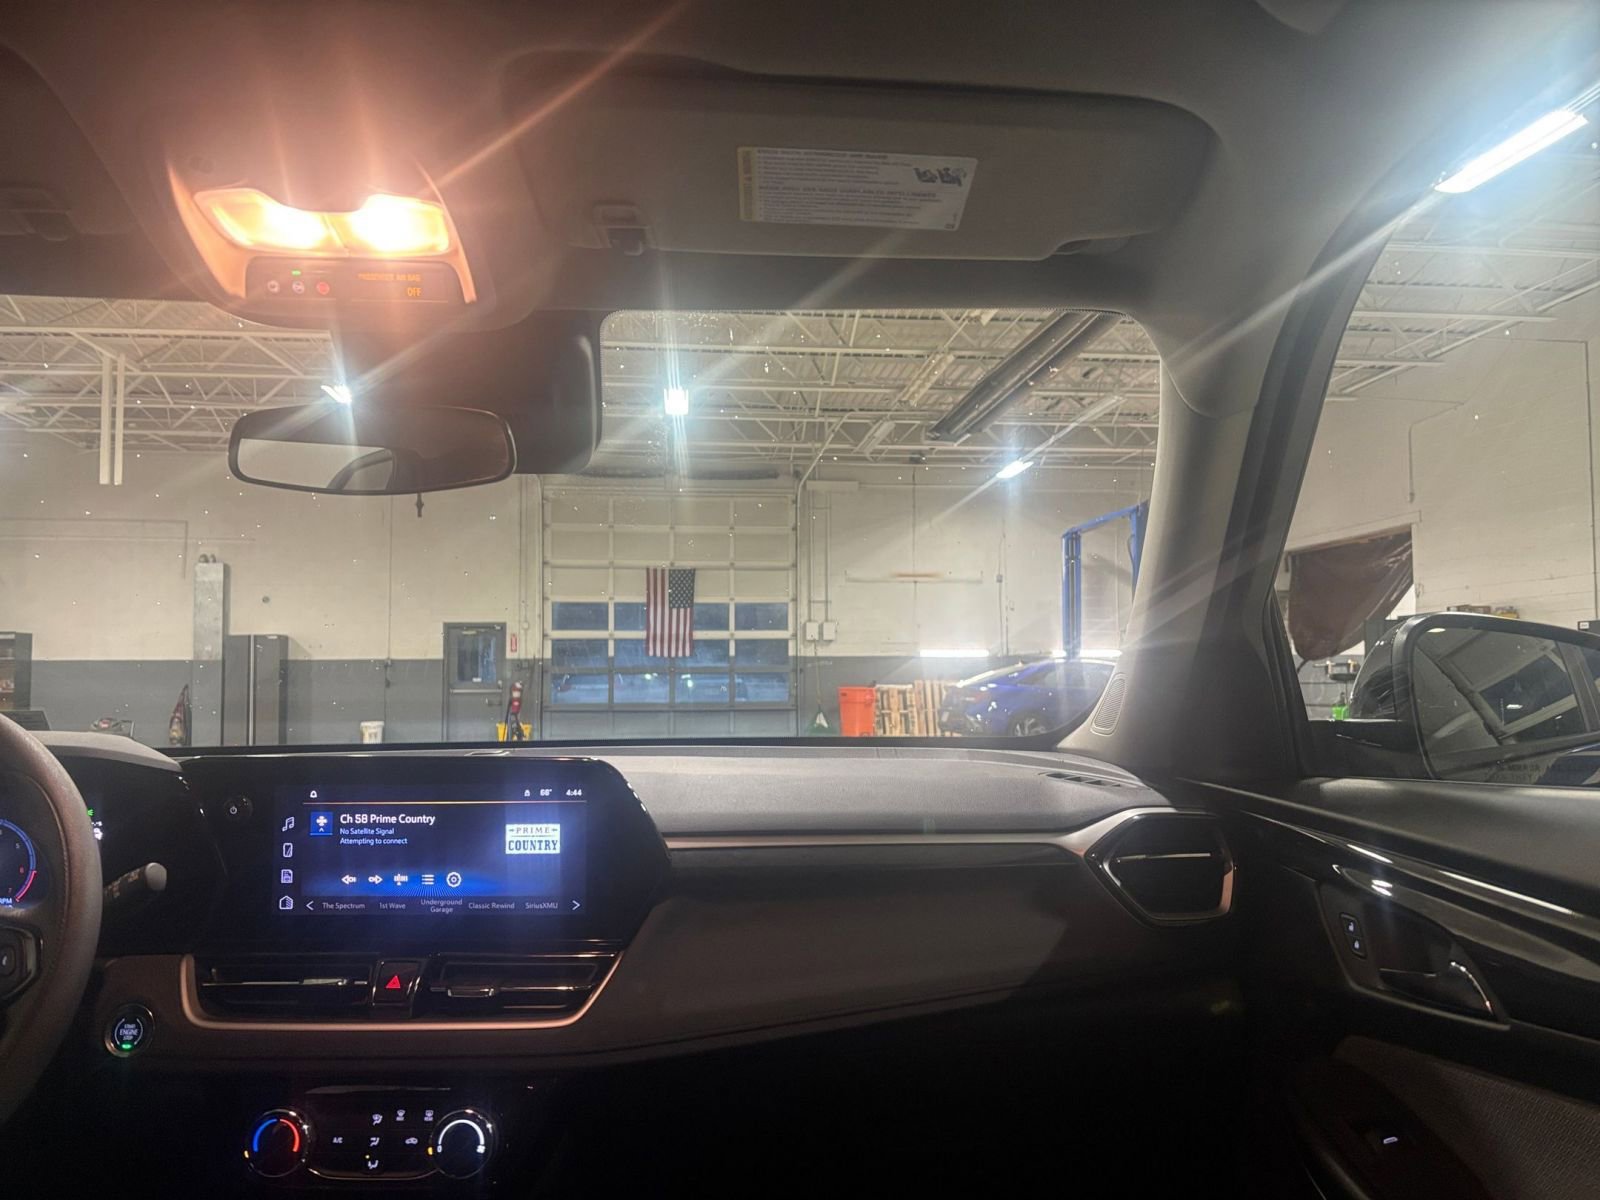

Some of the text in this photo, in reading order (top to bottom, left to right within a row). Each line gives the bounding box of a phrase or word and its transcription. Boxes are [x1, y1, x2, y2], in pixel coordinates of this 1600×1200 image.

[407, 287, 422, 297] OFF
[566, 788, 583, 797] 4:44
[340, 813, 436, 826] Ch 58 Prime Country
[350, 827, 375, 835] Satellite
[376, 827, 395, 836] Signal
[516, 826, 550, 834] PRIME
[340, 837, 408, 846] Attempting to connect
[508, 839, 558, 851] COUNTRY
[322, 902, 366, 911] The Spectrum
[379, 902, 406, 910] 1st Wave
[420, 898, 463, 907] Underground
[430, 906, 454, 914] Garage
